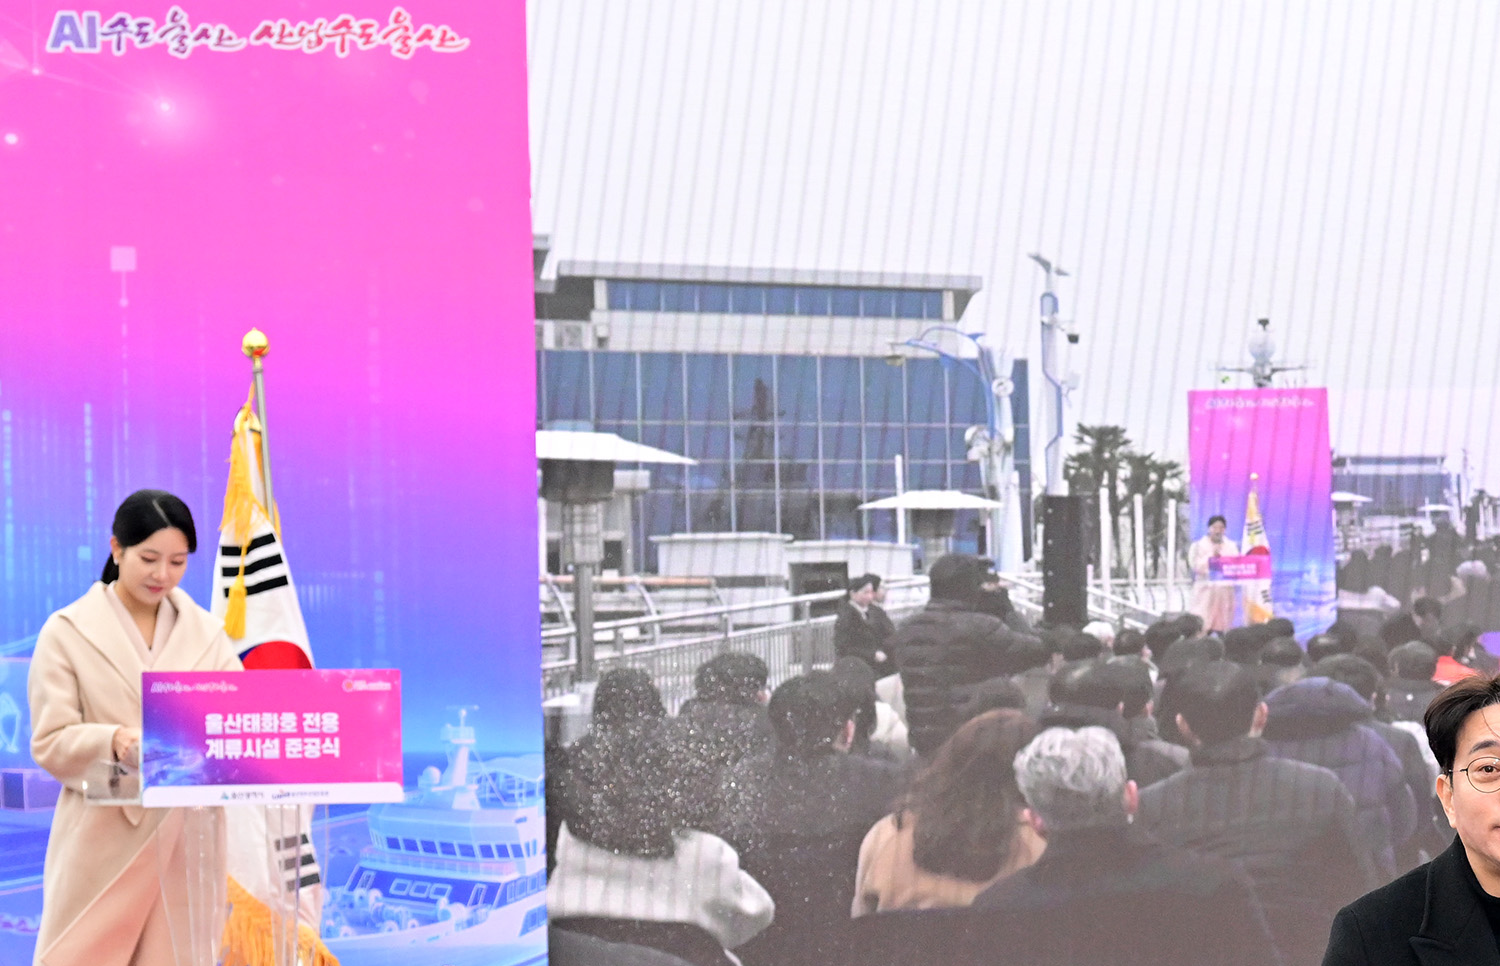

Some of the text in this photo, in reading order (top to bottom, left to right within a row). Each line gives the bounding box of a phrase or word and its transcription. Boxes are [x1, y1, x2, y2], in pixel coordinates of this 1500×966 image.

[204, 711, 340, 735] 울산태화호 전용
[204, 737, 340, 760] 계류시설 준공식
